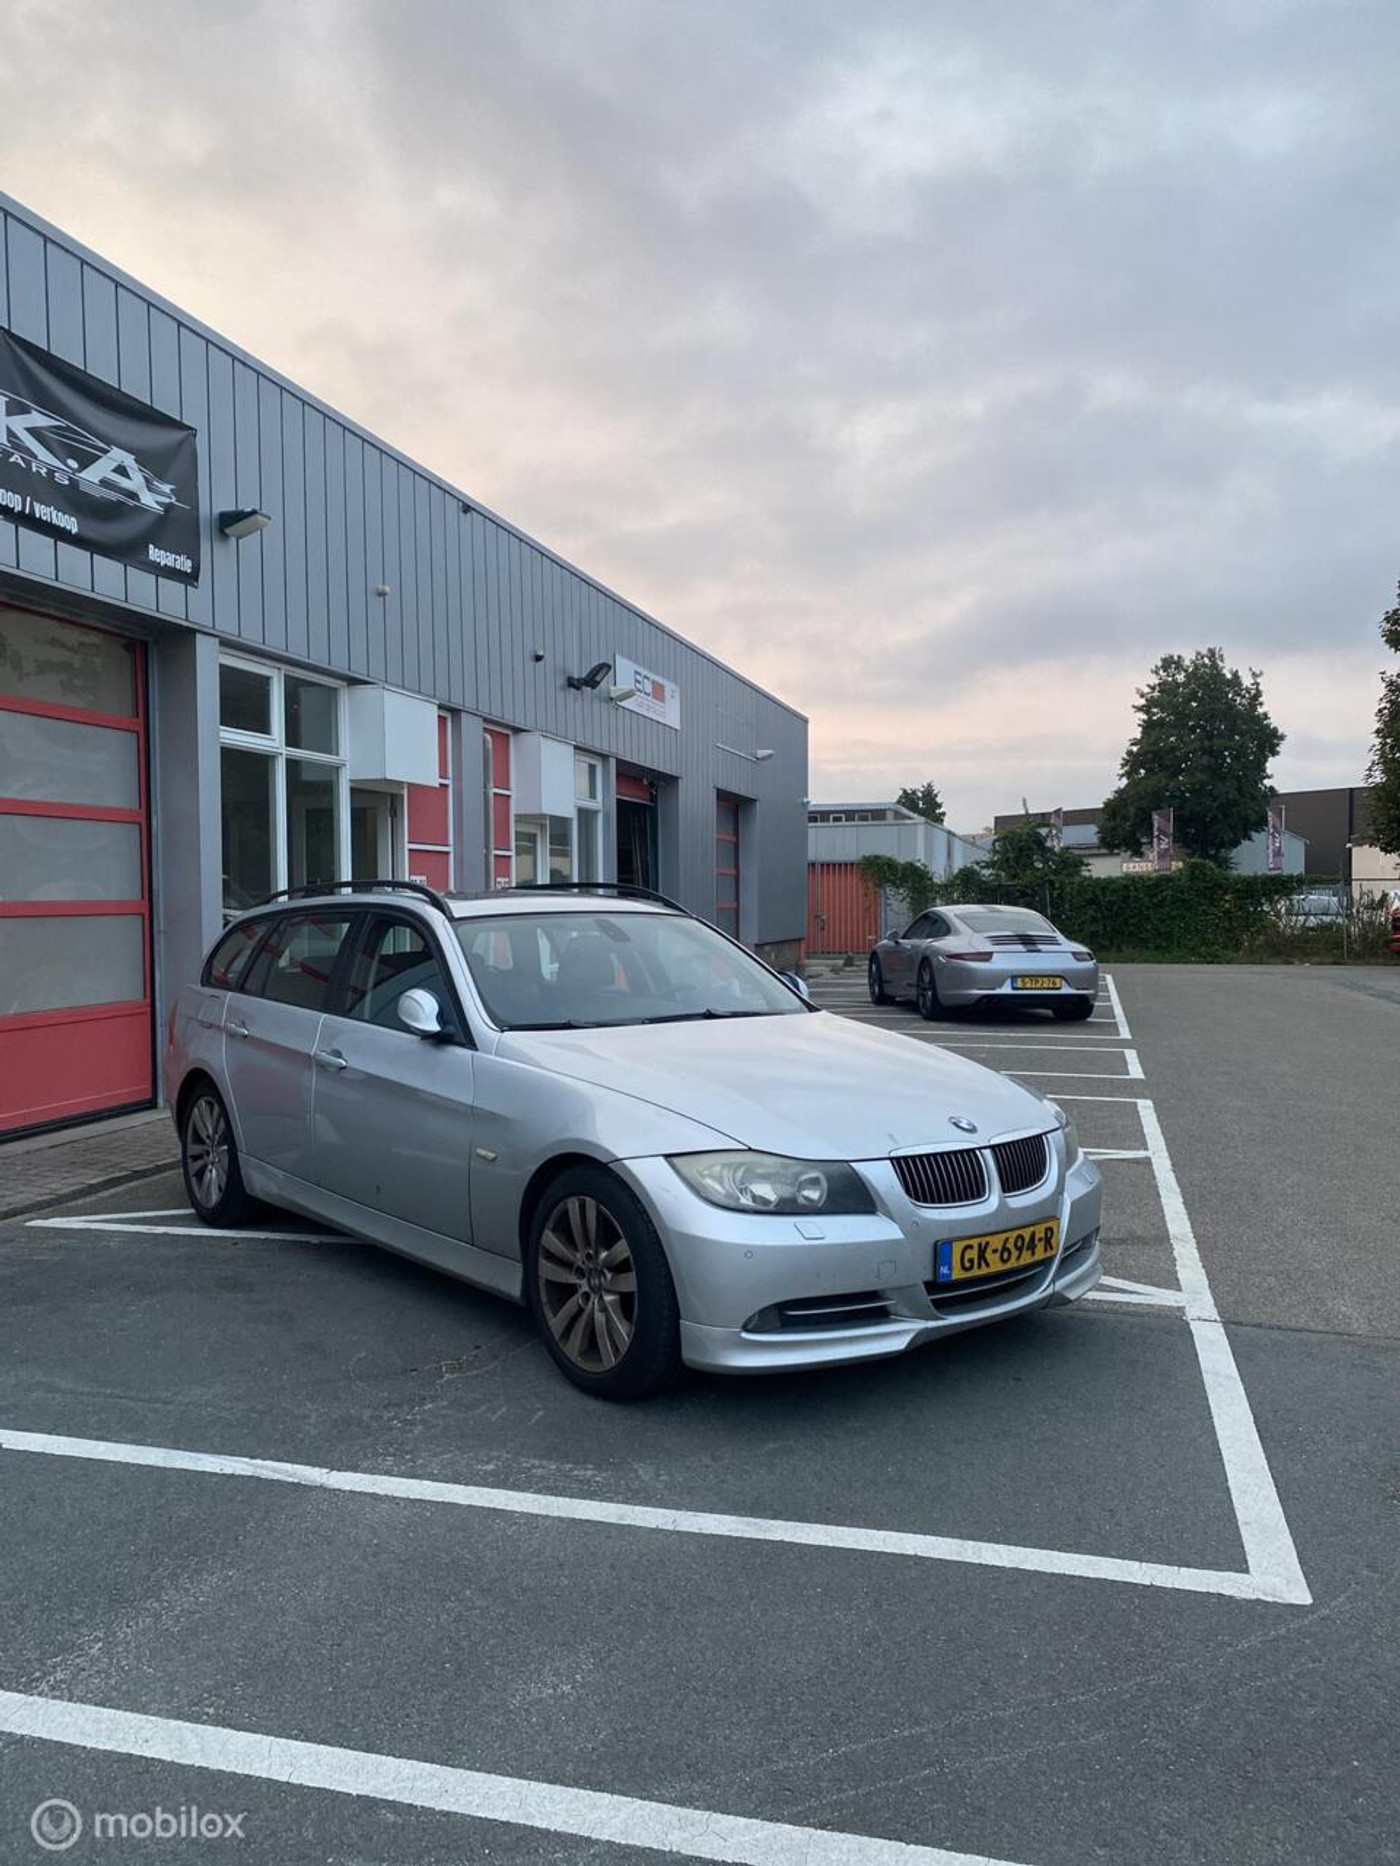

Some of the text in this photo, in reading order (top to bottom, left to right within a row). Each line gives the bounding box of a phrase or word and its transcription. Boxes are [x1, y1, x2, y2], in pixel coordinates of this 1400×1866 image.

[0, 449, 70, 485] ARS
[33, 501, 79, 535] verkoop
[148, 543, 192, 573] Reparatie
[960, 1226, 1054, 1272] GK-694-R
